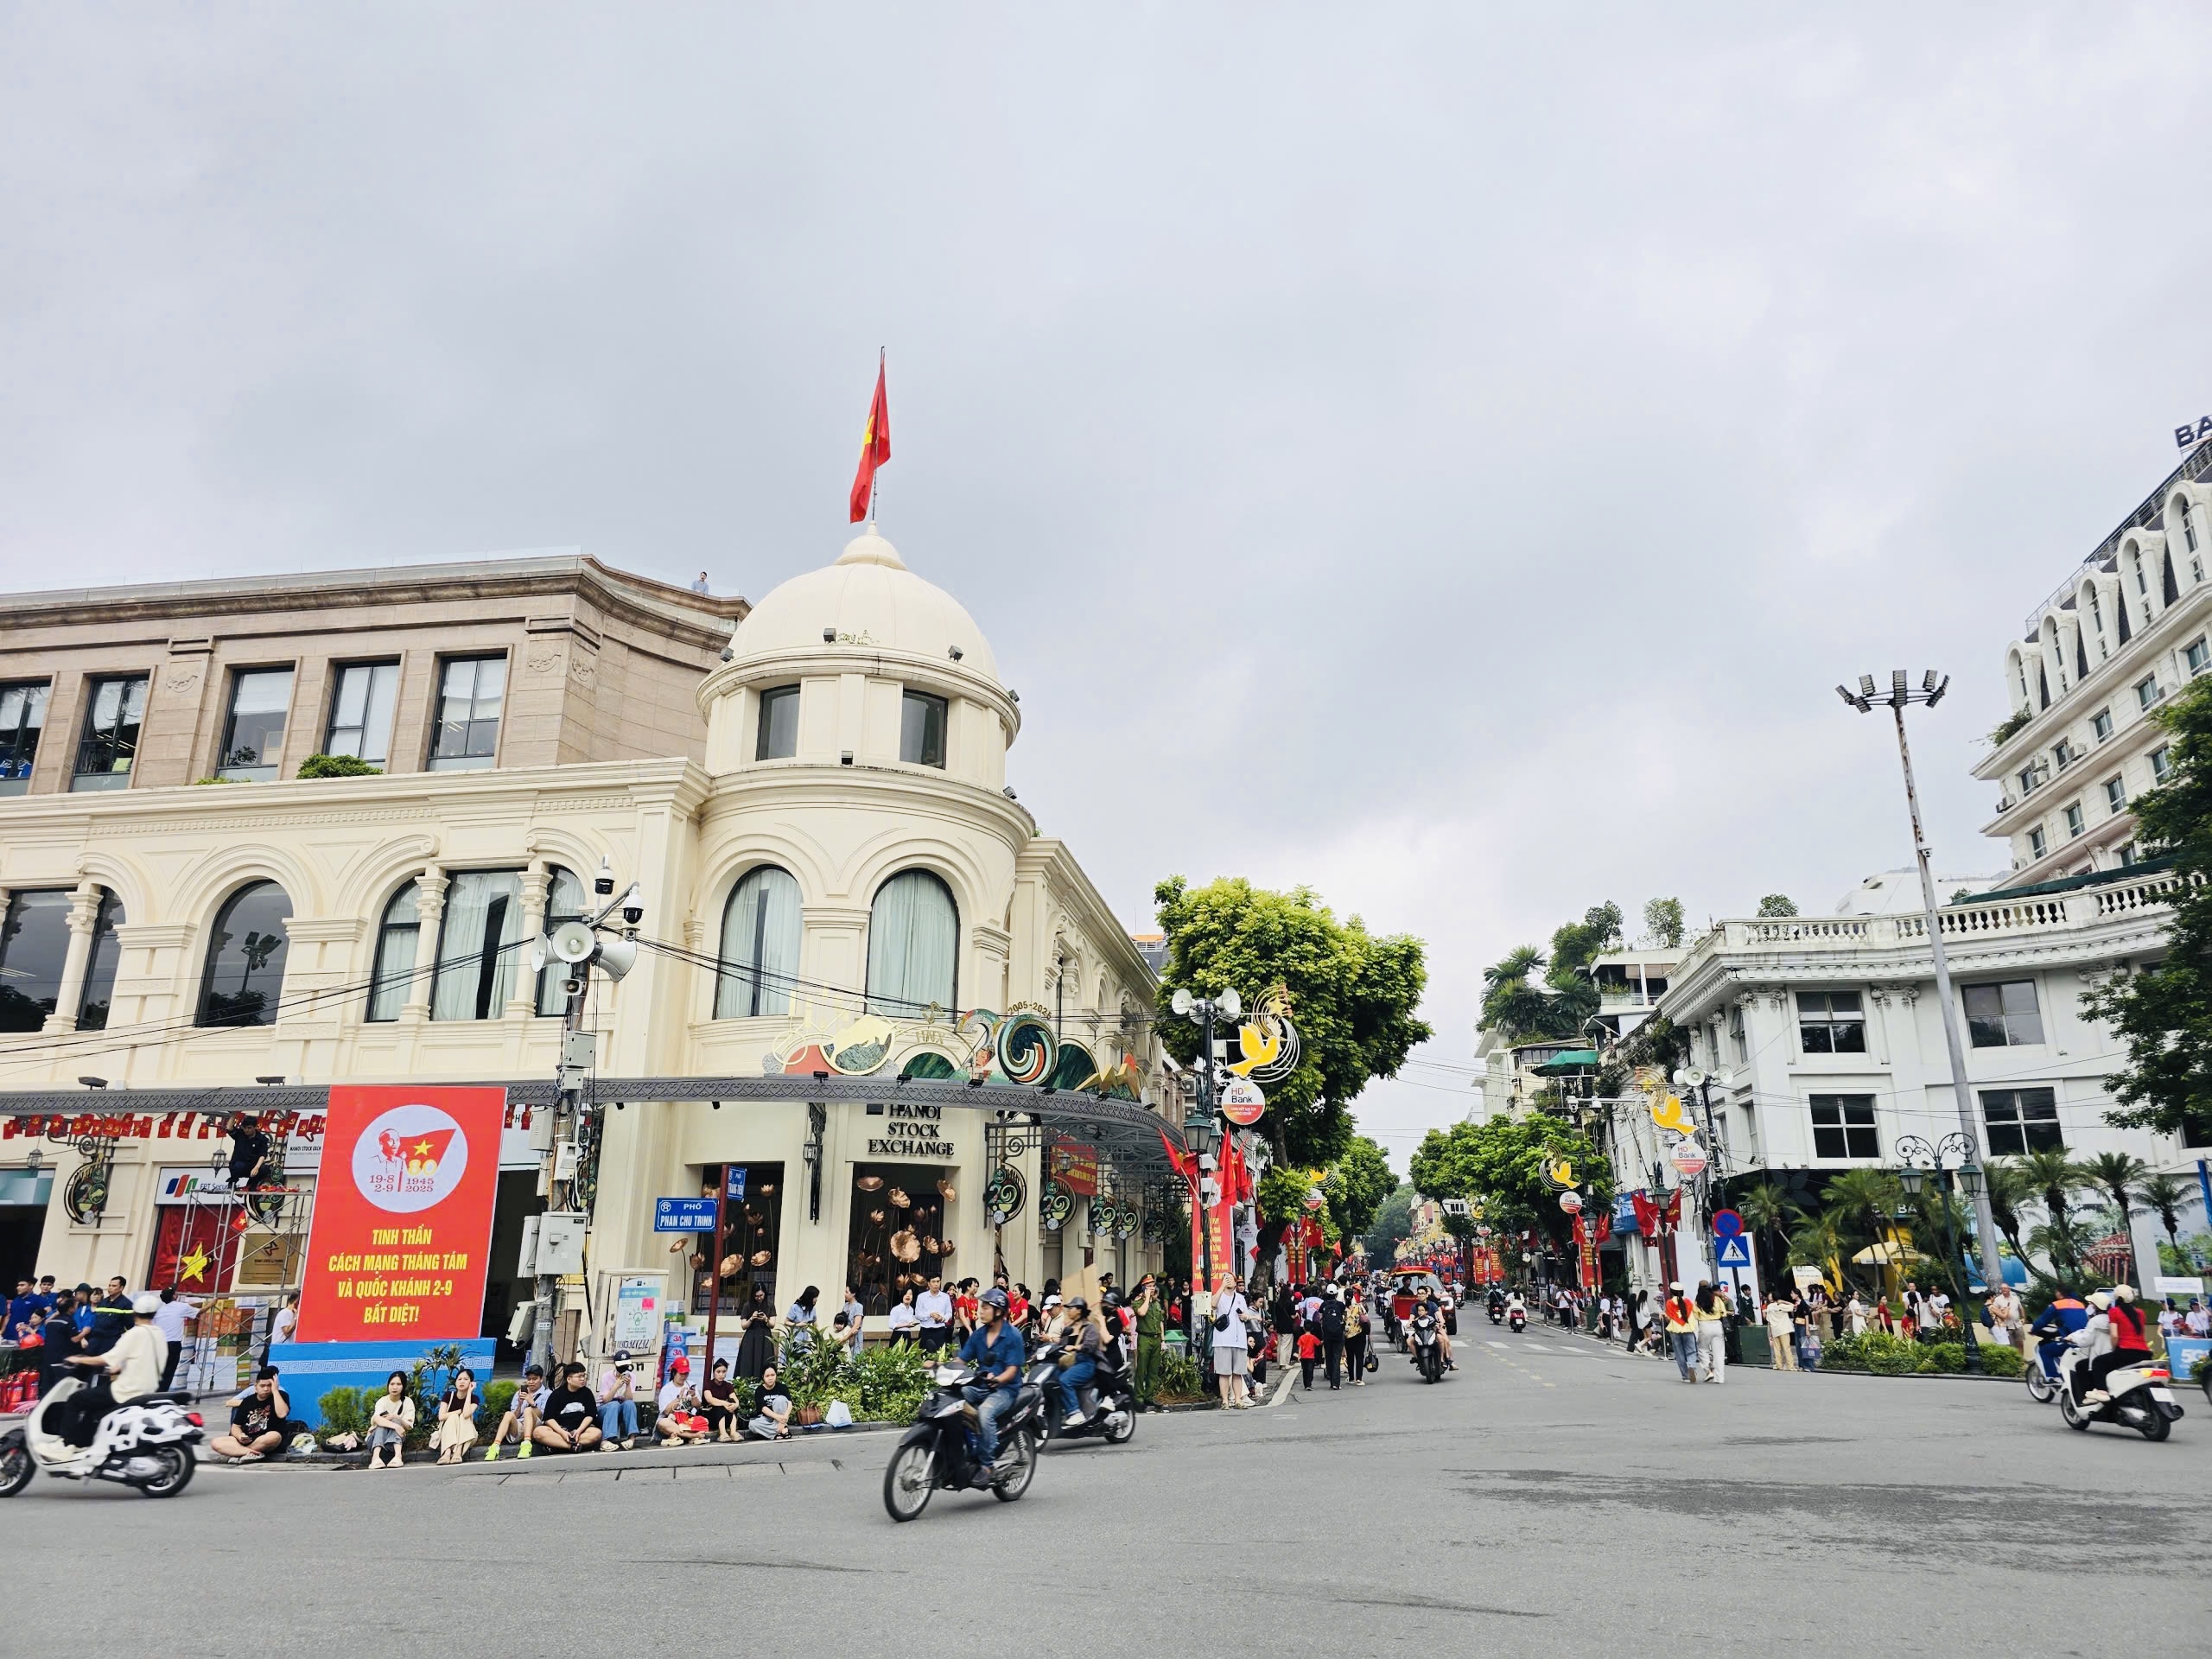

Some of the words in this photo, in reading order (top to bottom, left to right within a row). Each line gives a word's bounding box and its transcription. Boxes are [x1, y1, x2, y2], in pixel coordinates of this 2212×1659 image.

[1007, 1001, 1052, 1020] 2005-2025
[1231, 1087, 1244, 1096] HD
[1231, 1095, 1253, 1103] Bank
[889, 1103, 942, 1120] HANOI
[887, 1122, 940, 1138] STOCK
[868, 1139, 955, 1156] EXCHANGE
[407, 1159, 438, 1176] 80
[369, 1174, 395, 1184] 19-8
[373, 1184, 394, 1192] 2-9
[683, 1200, 702, 1211] PHỐ
[659, 1215, 678, 1227] PHAN
[679, 1215, 693, 1227] CHU
[694, 1215, 713, 1227] TRINH
[372, 1229, 399, 1245] TINH
[402, 1224, 433, 1245] THẦN
[328, 1252, 361, 1272] CÁCH
[363, 1255, 399, 1274] MẠNG
[402, 1251, 440, 1270] THÁNG
[442, 1250, 468, 1270] TÁM
[338, 1277, 353, 1298] VÀ
[355, 1274, 388, 1300] QUỐC
[390, 1277, 431, 1297] KHÁNH
[432, 1280, 453, 1296] 2-9
[363, 1300, 388, 1324] BẤT
[389, 1303, 420, 1326] DIỆT!
